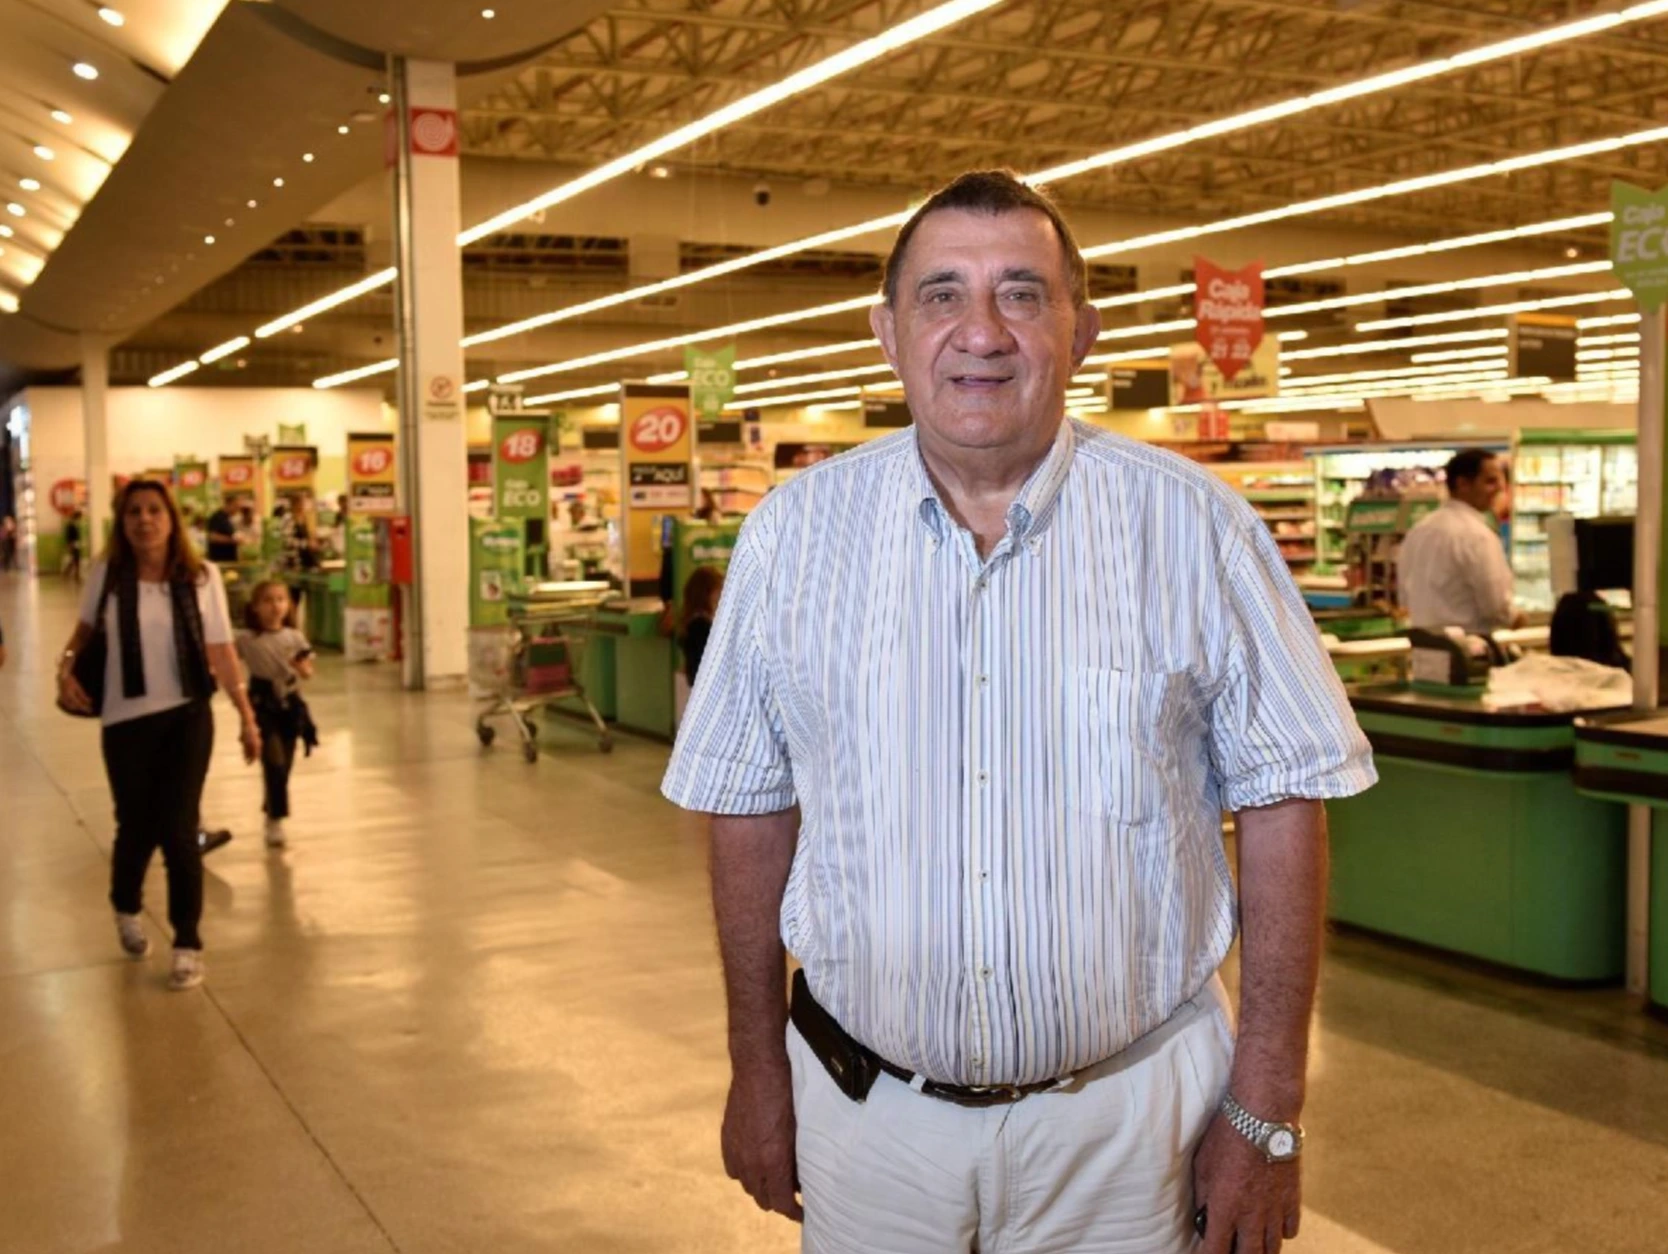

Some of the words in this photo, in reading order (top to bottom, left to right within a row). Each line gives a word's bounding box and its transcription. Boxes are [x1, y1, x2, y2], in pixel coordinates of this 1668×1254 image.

[1617, 226, 1668, 262] EC
[1208, 278, 1250, 302] Caja
[635, 412, 681, 444] 20
[508, 431, 537, 458] 18
[502, 489, 541, 507] ECO
